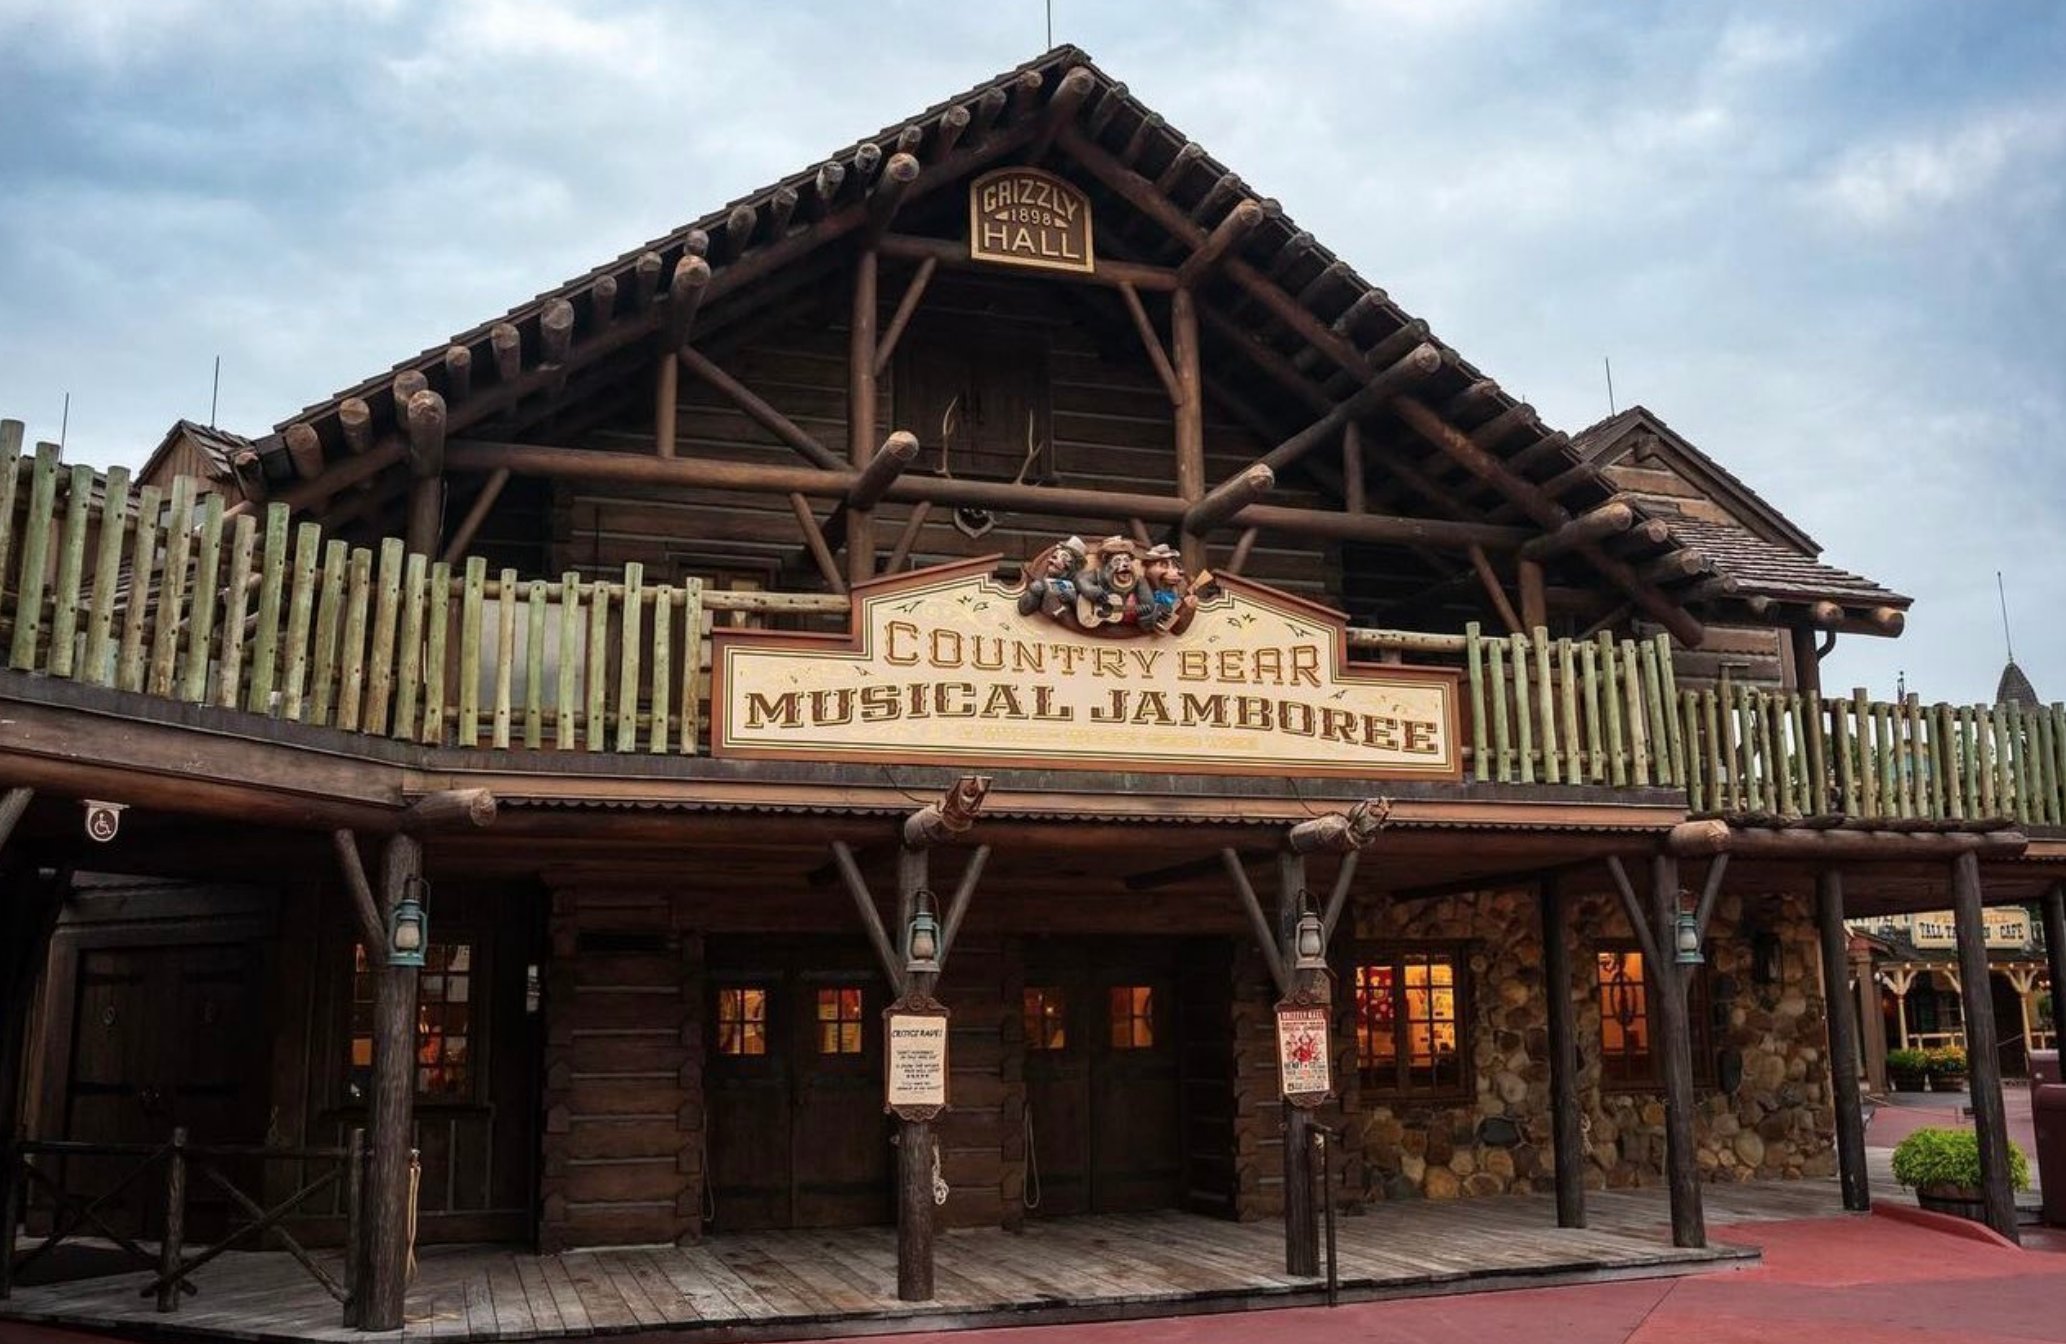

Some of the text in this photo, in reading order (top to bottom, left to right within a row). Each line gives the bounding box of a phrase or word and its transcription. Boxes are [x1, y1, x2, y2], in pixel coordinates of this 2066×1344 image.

[984, 179, 1078, 221] GRIZZLY
[1011, 208, 1051, 225] 1898
[984, 223, 1080, 258] HALL
[884, 620, 1321, 687] COUNTRY BEAR
[744, 681, 1074, 729] MUSICAL
[1091, 690, 1438, 754] JAMBOREE
[1919, 922, 1943, 939] TALL
